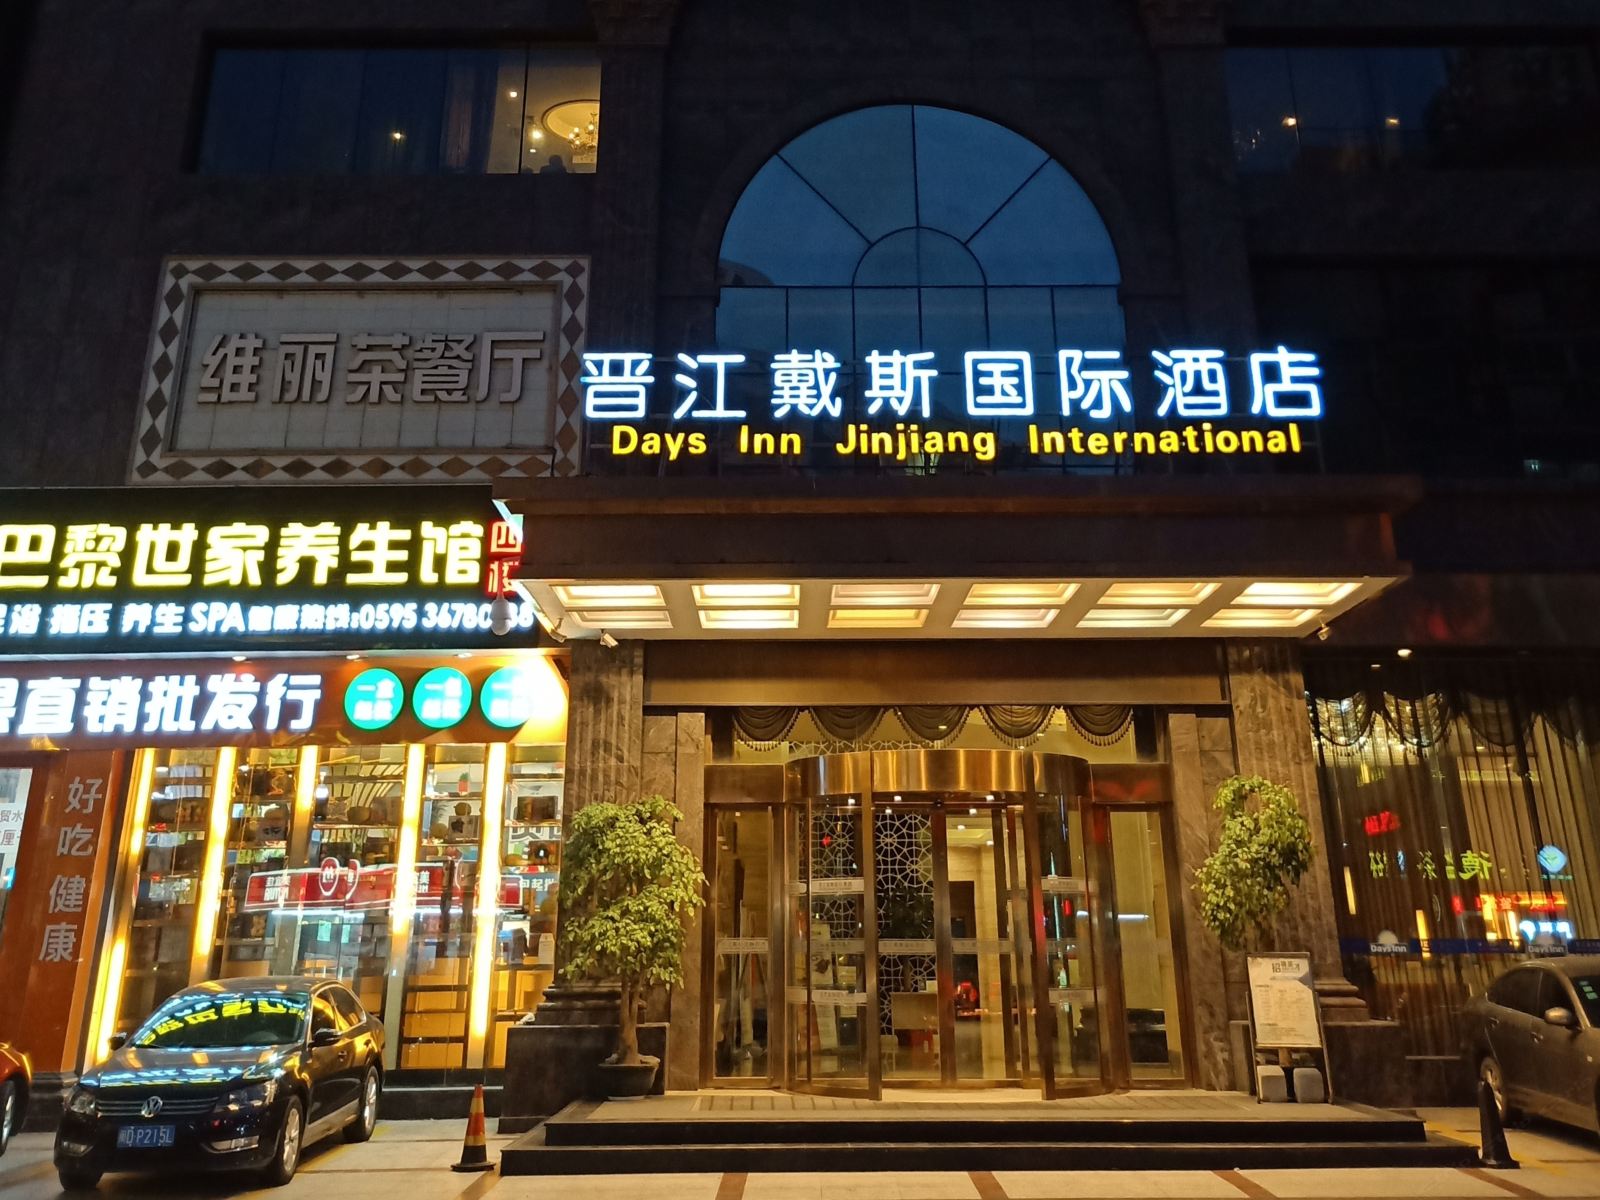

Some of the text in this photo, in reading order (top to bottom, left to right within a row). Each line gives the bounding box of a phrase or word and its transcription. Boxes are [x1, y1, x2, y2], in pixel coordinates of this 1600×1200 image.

[198, 331, 544, 404] 维丽茶餐厅
[580, 346, 1323, 421] 晋江戴斯国际酒店
[611, 423, 1302, 464] Days Inn Jinjiang International
[0, 521, 484, 588] 巴黎世家养生馆
[0, 603, 41, 635] 浴
[188, 602, 246, 633] SPA
[39, 776, 103, 962] 好吃健康
